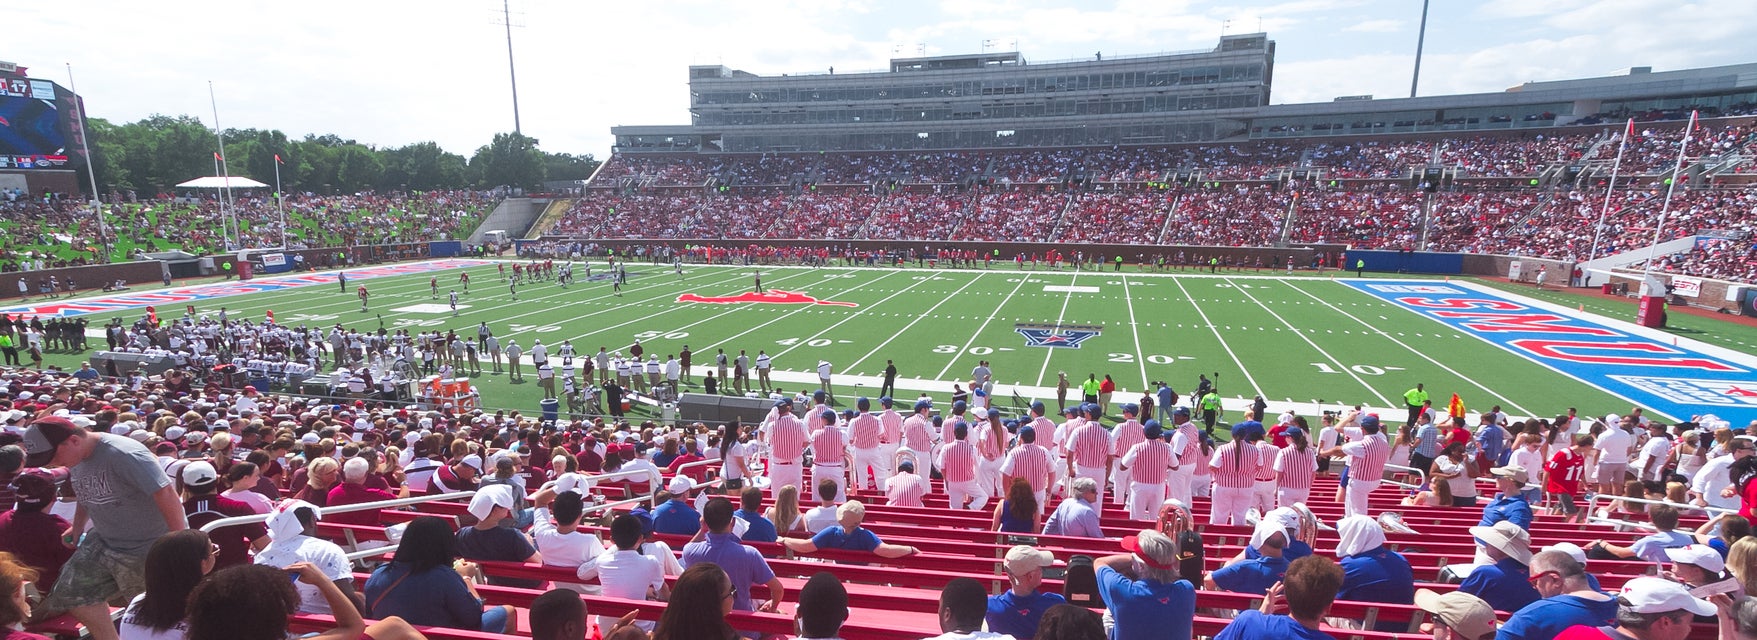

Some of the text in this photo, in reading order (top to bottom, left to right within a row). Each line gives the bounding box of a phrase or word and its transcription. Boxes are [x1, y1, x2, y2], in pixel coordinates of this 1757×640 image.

[11, 83, 27, 93] 17
[1674, 280, 1699, 290] ESPN
[633, 330, 690, 339] 50
[1392, 296, 1751, 374] SMU
[775, 337, 832, 347] 40
[931, 344, 994, 355] 30
[1107, 353, 1174, 365] 20
[1309, 362, 1385, 376] 10
[1565, 465, 1583, 481] 11
